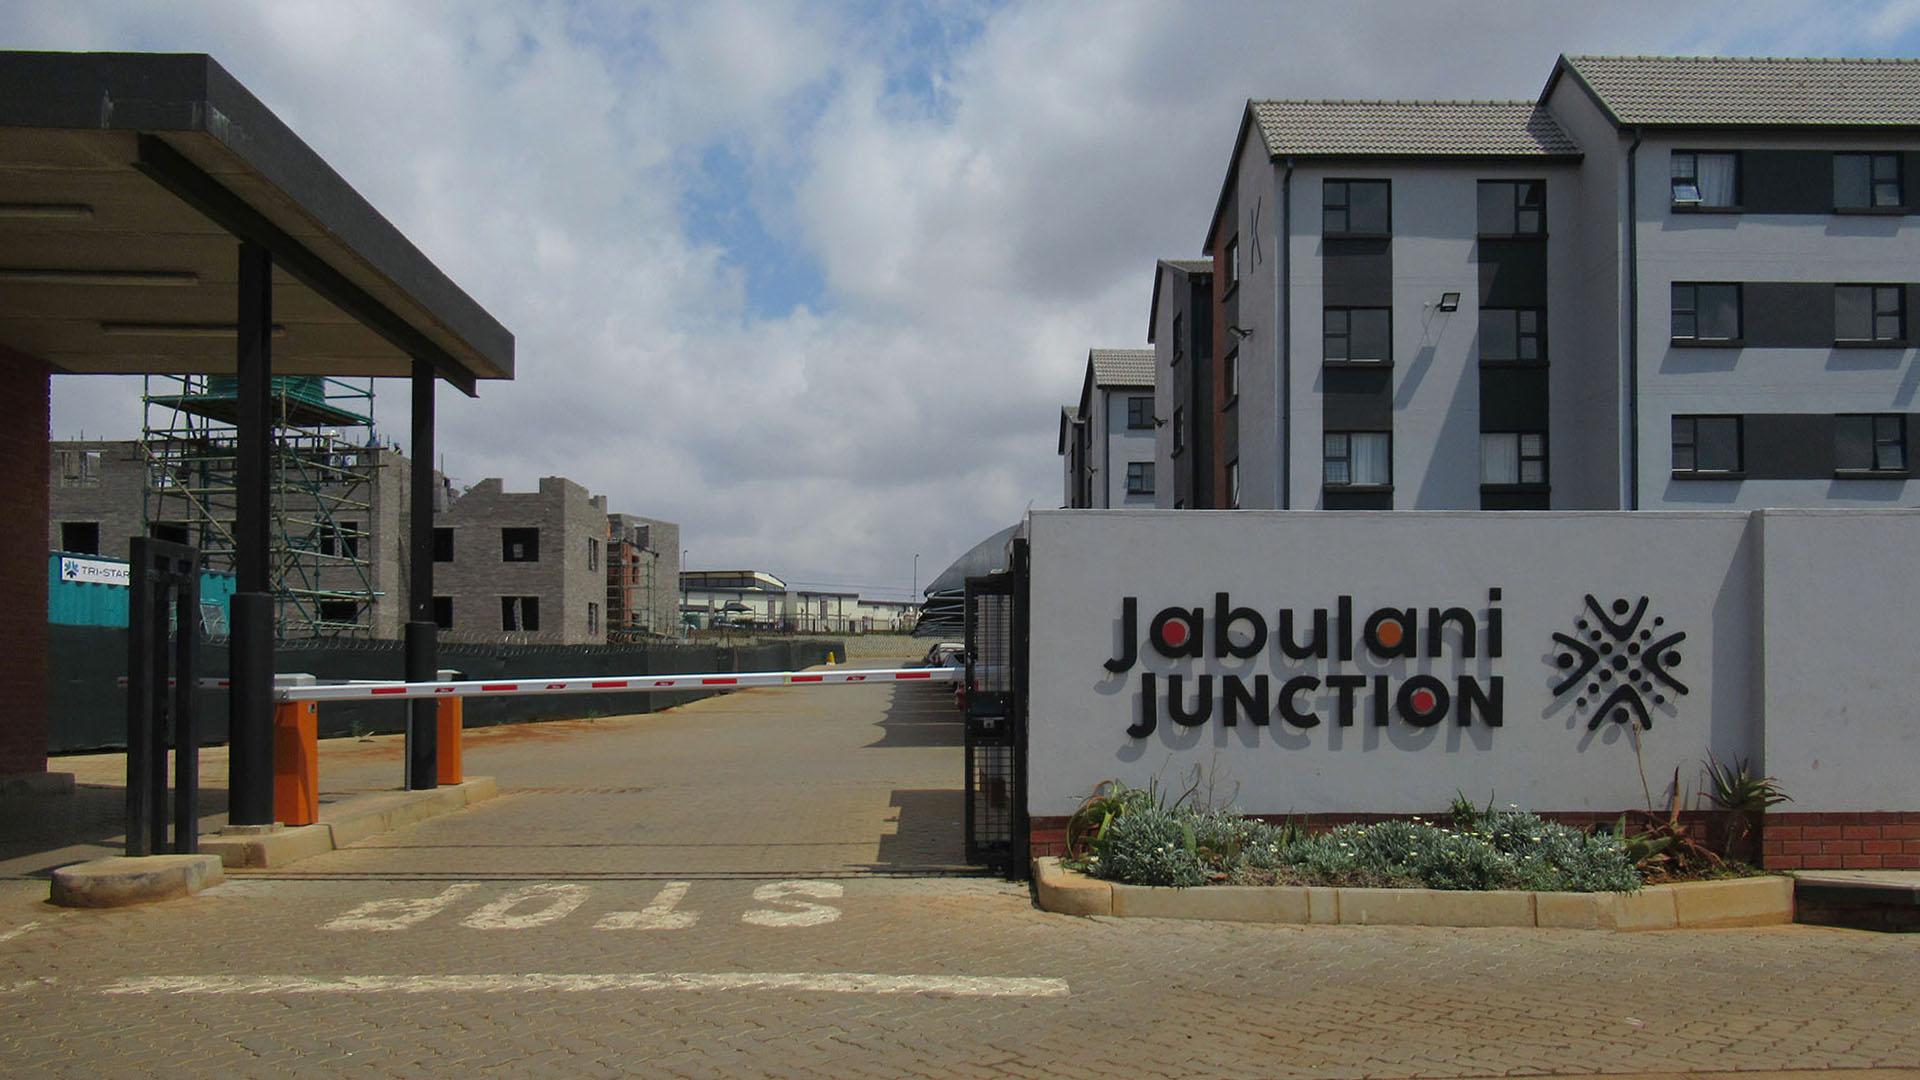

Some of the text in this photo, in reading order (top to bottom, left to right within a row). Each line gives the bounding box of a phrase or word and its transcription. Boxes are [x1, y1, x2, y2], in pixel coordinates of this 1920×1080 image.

[1103, 588, 1502, 673] Jabulani
[1126, 673, 1504, 738] JUNCTION
[316, 880, 844, 930] STOP
